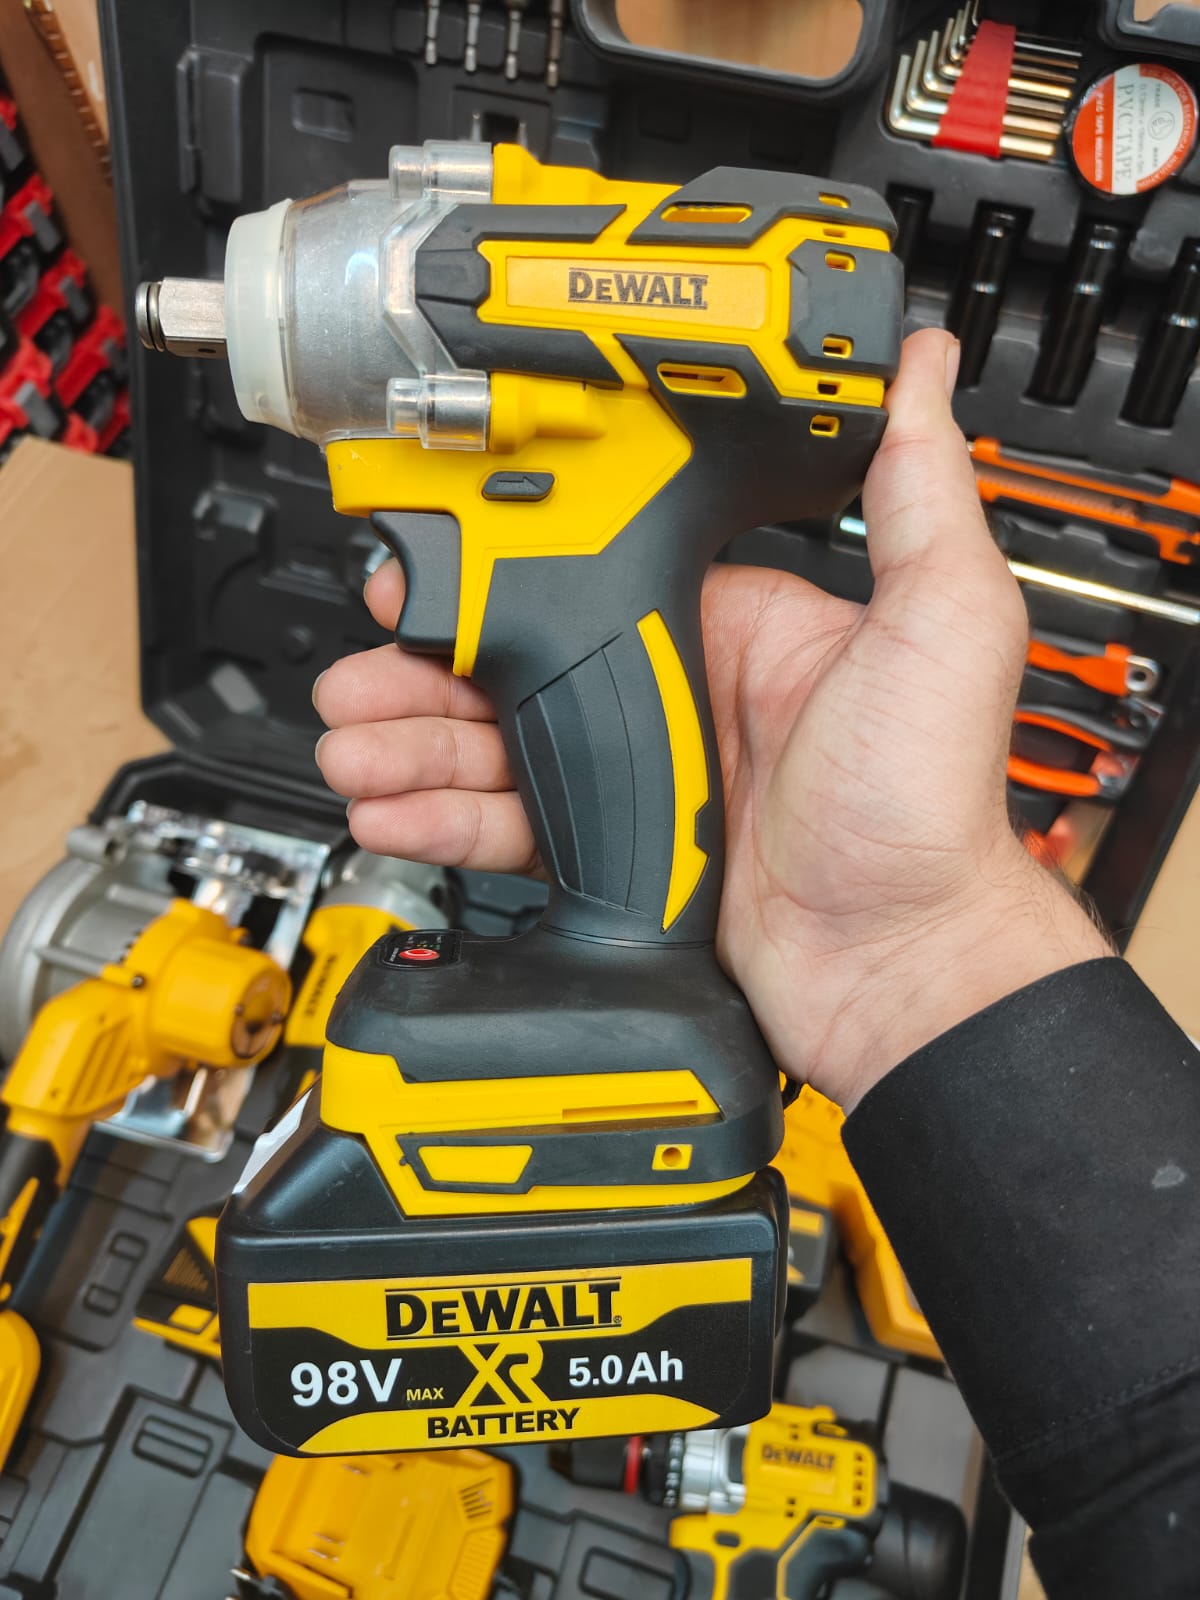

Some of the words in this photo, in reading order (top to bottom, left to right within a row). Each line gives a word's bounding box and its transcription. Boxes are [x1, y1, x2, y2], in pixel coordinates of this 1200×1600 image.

[290, 1358, 402, 1407] 98V
[406, 1387, 445, 1401] MAX
[454, 1341, 553, 1409] XR
[427, 1407, 581, 1439] BATTERY
